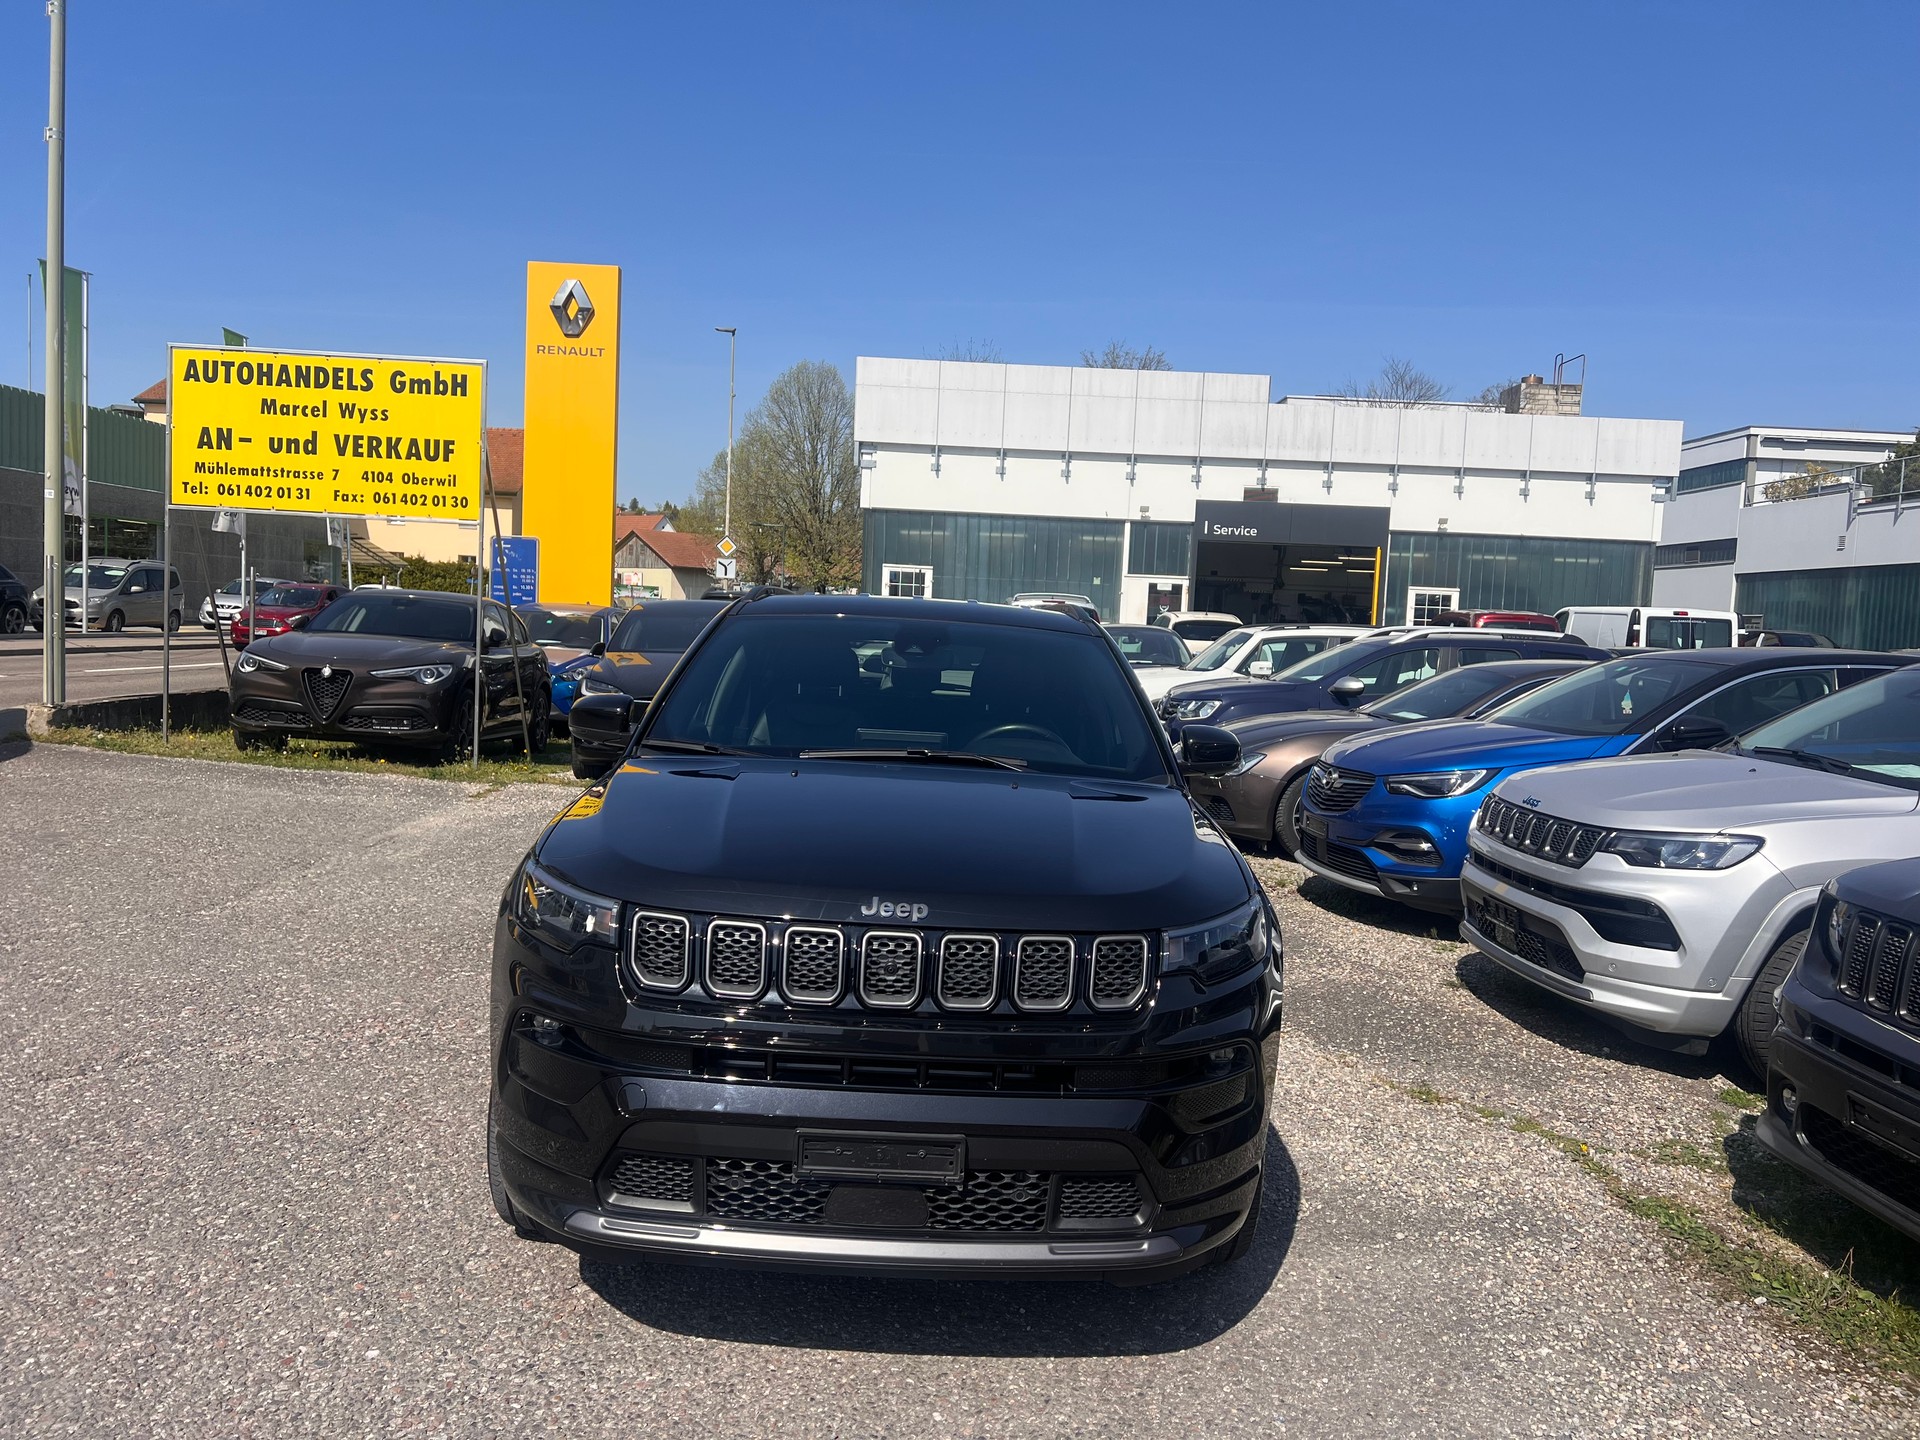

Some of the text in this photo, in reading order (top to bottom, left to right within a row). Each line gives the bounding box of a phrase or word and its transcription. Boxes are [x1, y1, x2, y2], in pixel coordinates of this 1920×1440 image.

[536, 344, 606, 358] RENAULT
[183, 358, 468, 397] AUTOHANDELS GmbH
[260, 398, 390, 424] Marcel Wyss
[268, 430, 318, 456] und
[333, 433, 455, 463] VERKAUF
[194, 461, 457, 488] Mühlemattstrasse 7 4104 Oberwil
[181, 481, 209, 495] Tel:
[333, 489, 365, 503] Fax:
[1213, 524, 1258, 537] Service
[860, 896, 929, 922] Jeep
